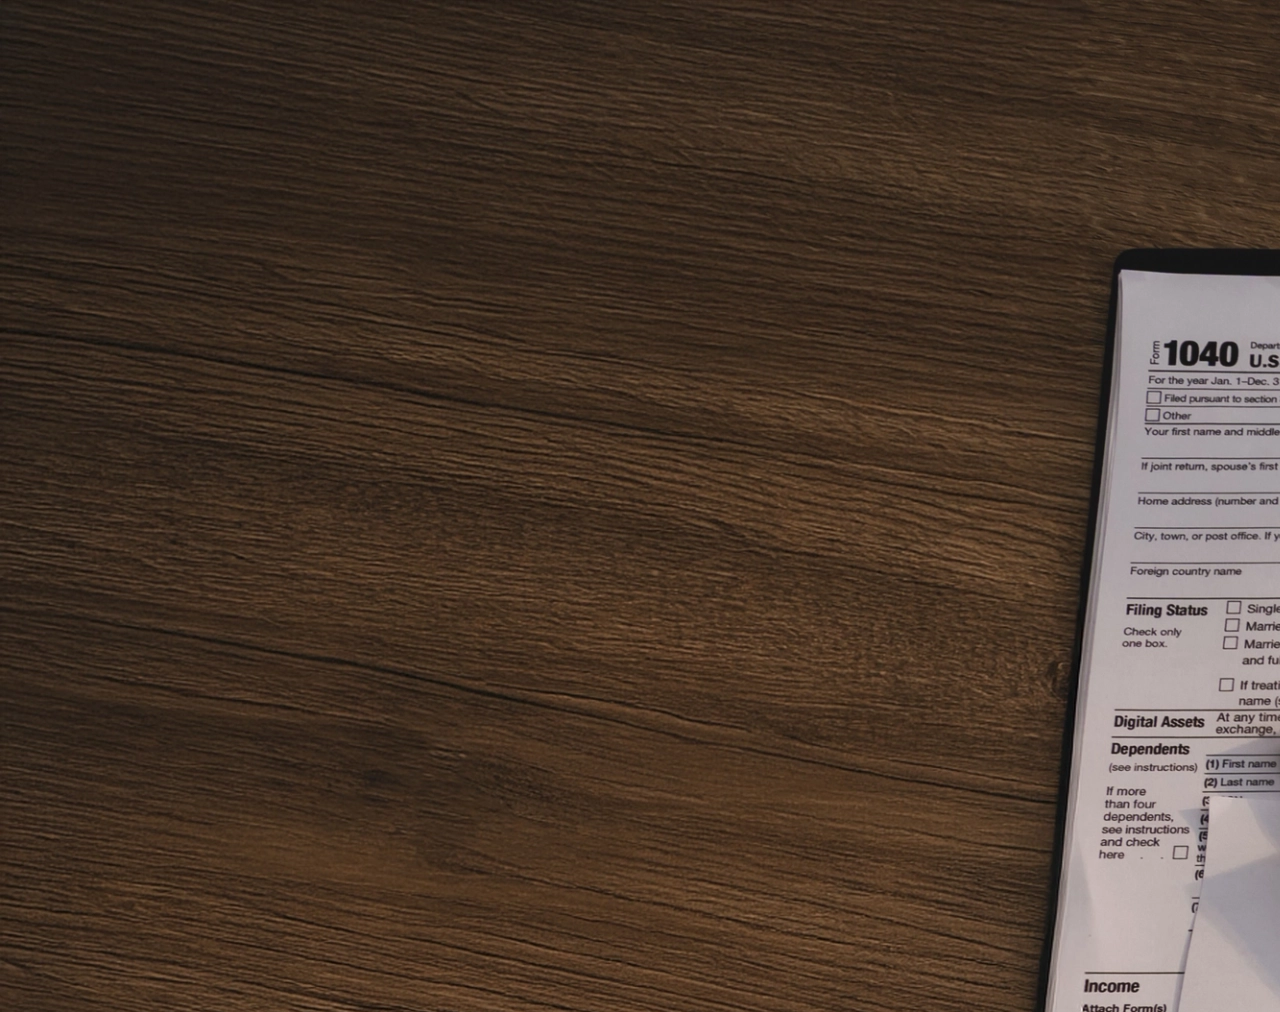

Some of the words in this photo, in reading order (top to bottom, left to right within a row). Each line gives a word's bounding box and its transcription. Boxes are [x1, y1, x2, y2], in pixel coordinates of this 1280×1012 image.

[1150, 340, 1162, 366] Form
[1163, 339, 1240, 368] 1040
[1143, 426, 1170, 436] Your
[1170, 426, 1191, 436] first
[1192, 428, 1222, 436] name
[1223, 427, 1244, 436] and
[1245, 427, 1280, 437] middle
[1129, 565, 1170, 578] Foreign
[1171, 566, 1212, 578] country
[1213, 568, 1243, 576] name
[1125, 602, 1163, 619] Filing
[1165, 603, 1208, 617] Status
[1122, 626, 1157, 637] Check
[1159, 626, 1183, 639] only
[1121, 639, 1143, 648] one
[1144, 638, 1168, 648] box.
[1113, 714, 1158, 731] Digital
[1159, 715, 1206, 729] Assets
[1110, 741, 1191, 758] Dependents
[1108, 762, 1132, 774] (see
[1133, 761, 1198, 774] instructions)
[1083, 978, 1140, 994] Income
